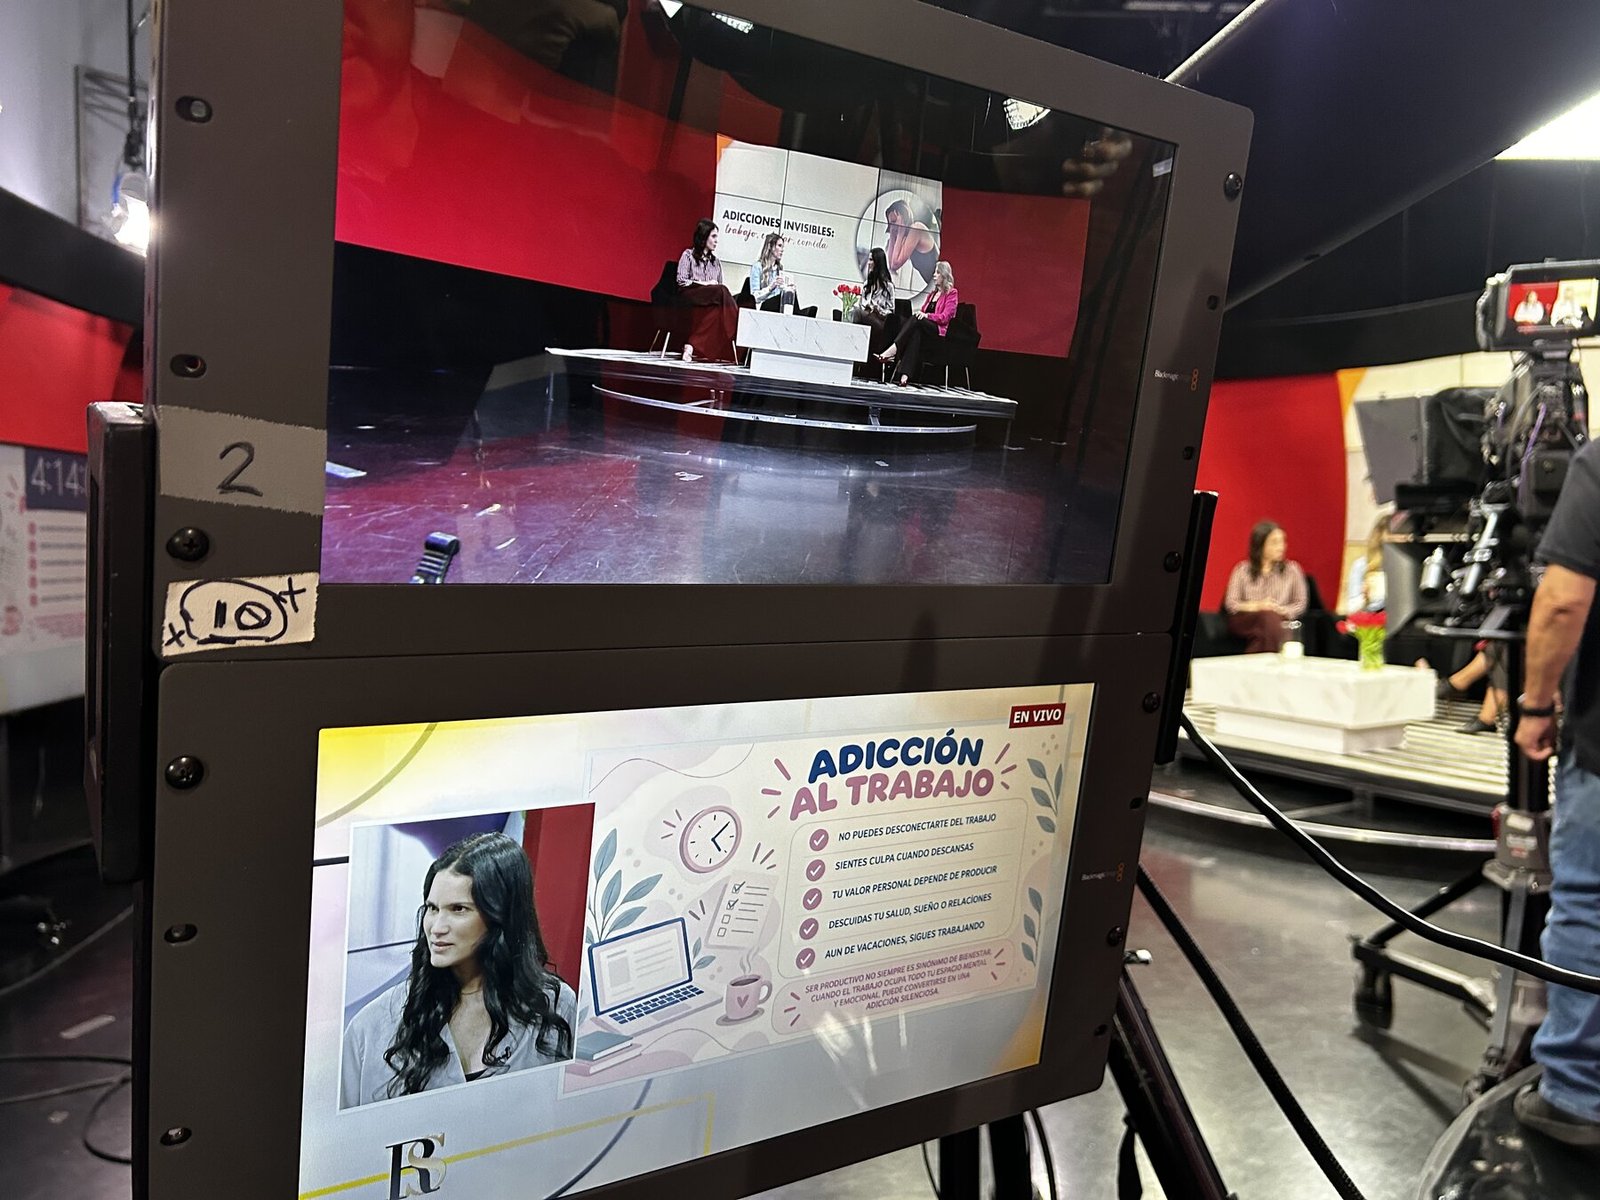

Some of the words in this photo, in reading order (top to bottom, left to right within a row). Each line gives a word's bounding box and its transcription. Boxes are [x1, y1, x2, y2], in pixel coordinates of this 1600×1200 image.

[723, 210, 780, 228] ADICCIONES
[784, 220, 835, 238] INVISIBLES:
[797, 238, 828, 249] comida
[216, 442, 263, 497] 2
[1013, 711, 1030, 723] EN
[1032, 708, 1062, 722] VIVO
[808, 728, 984, 784] ADICCIÓN
[789, 782, 838, 821] AL
[845, 768, 994, 805] TRABAJO
[838, 832, 851, 841] NO
[852, 828, 884, 839] PUEDES
[885, 819, 949, 836] DESCONECTARTE
[950, 817, 964, 826] DEL
[965, 813, 997, 824] TRABAJO
[835, 858, 868, 871] SIENTES
[869, 854, 895, 866] CULPA
[896, 849, 930, 863] CUANDO
[931, 843, 974, 857] DESCANSAS
[833, 890, 843, 899] TU
[844, 885, 871, 898] VALOR
[872, 879, 912, 893] PERSONAL
[913, 872, 948, 886] DEPENDE
[949, 871, 960, 880] DE
[960, 865, 998, 878] PRODUCIR
[828, 914, 872, 929] DESCUIDAS
[873, 911, 884, 921] TU
[885, 907, 912, 919] SALUD,
[913, 902, 939, 915] SUEÑO
[941, 901, 947, 909] O
[825, 948, 843, 959] AUN
[844, 945, 856, 956] DE
[857, 935, 908, 953] VACACIONES,
[909, 929, 936, 942] SIGUES
[937, 921, 985, 937] TRABAJANDO
[805, 984, 819, 993] SER
[820, 975, 864, 990] PRODUCTIVO
[865, 972, 876, 980] NO
[877, 965, 906, 978] SIEMPRE
[906, 964, 915, 972] ES
[949, 955, 958, 963] DE
[811, 990, 841, 1002] CUANDO
[853, 981, 883, 993] TRABAJO
[884, 975, 906, 986] OCUPA
[908, 971, 926, 980] TODO
[927, 969, 935, 977] TU
[936, 964, 962, 975] ESPACIO
[963, 959, 987, 969] MENTAL
[834, 999, 839, 1007] Y
[882, 986, 904, 997] PUEDE
[904, 976, 947, 991] CONVERTIRSE
[947, 974, 957, 982] EN
[957, 972, 970, 980] UNA
